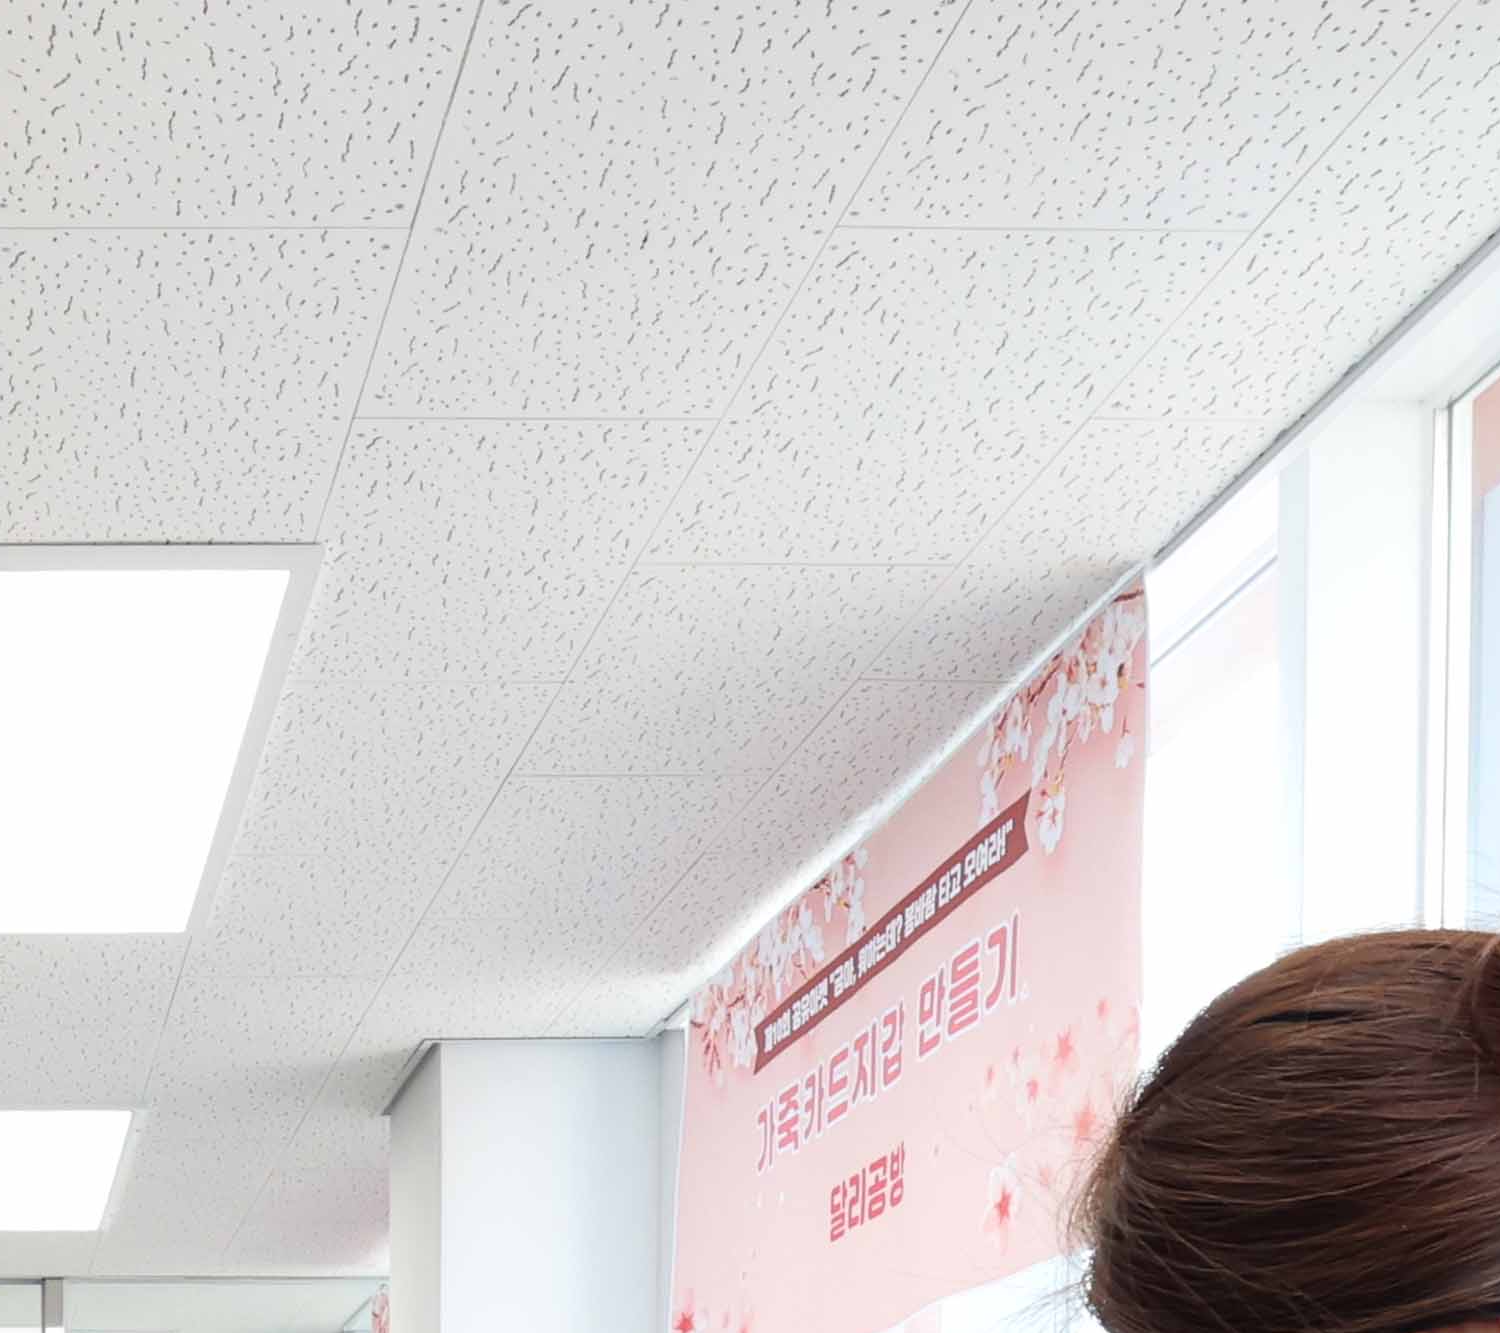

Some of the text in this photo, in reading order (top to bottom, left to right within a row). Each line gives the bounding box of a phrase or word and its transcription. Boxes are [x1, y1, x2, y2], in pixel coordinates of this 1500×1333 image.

[938, 862, 962, 908] 타고
[757, 912, 1018, 1172] 가죽카드지갑 만들기
[829, 1142, 905, 1242] 달리공방
